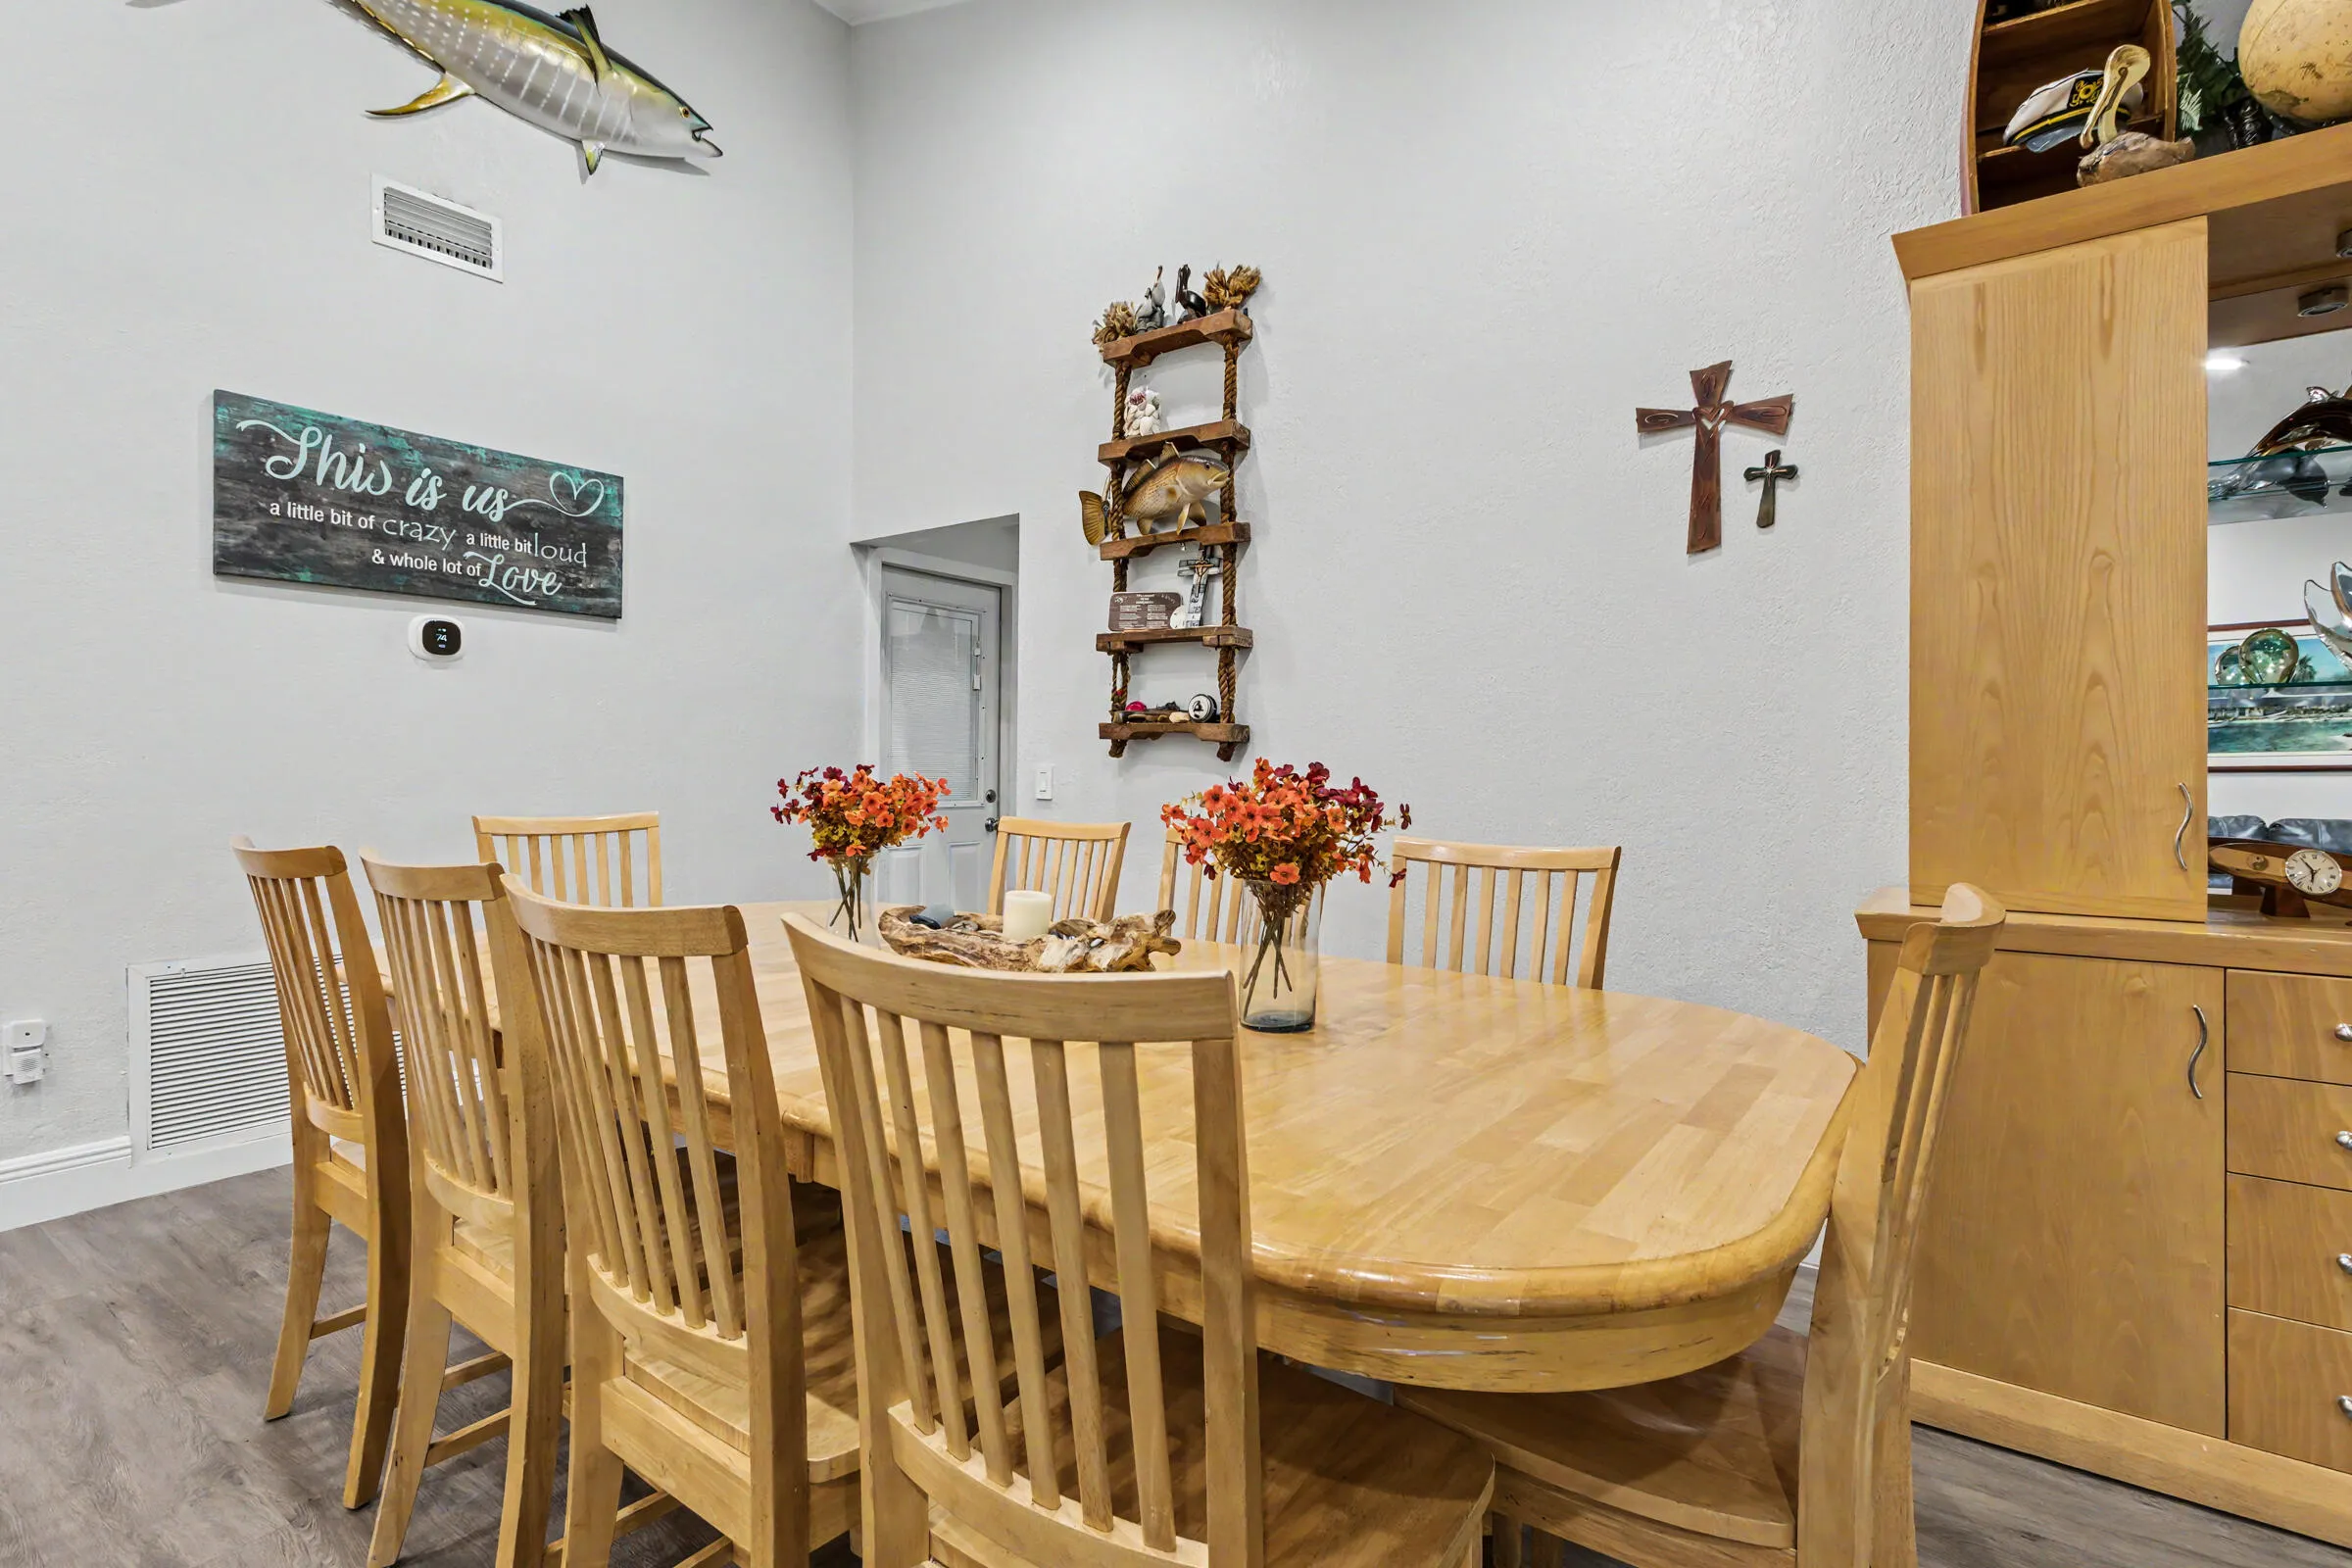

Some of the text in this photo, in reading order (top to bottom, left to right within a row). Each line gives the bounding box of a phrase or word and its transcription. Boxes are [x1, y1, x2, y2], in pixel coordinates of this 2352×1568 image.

[236, 419, 510, 522] This is us
[270, 501, 587, 568] a little bit of crazy a little bit loud
[371, 548, 563, 606] & whole lot of Love
